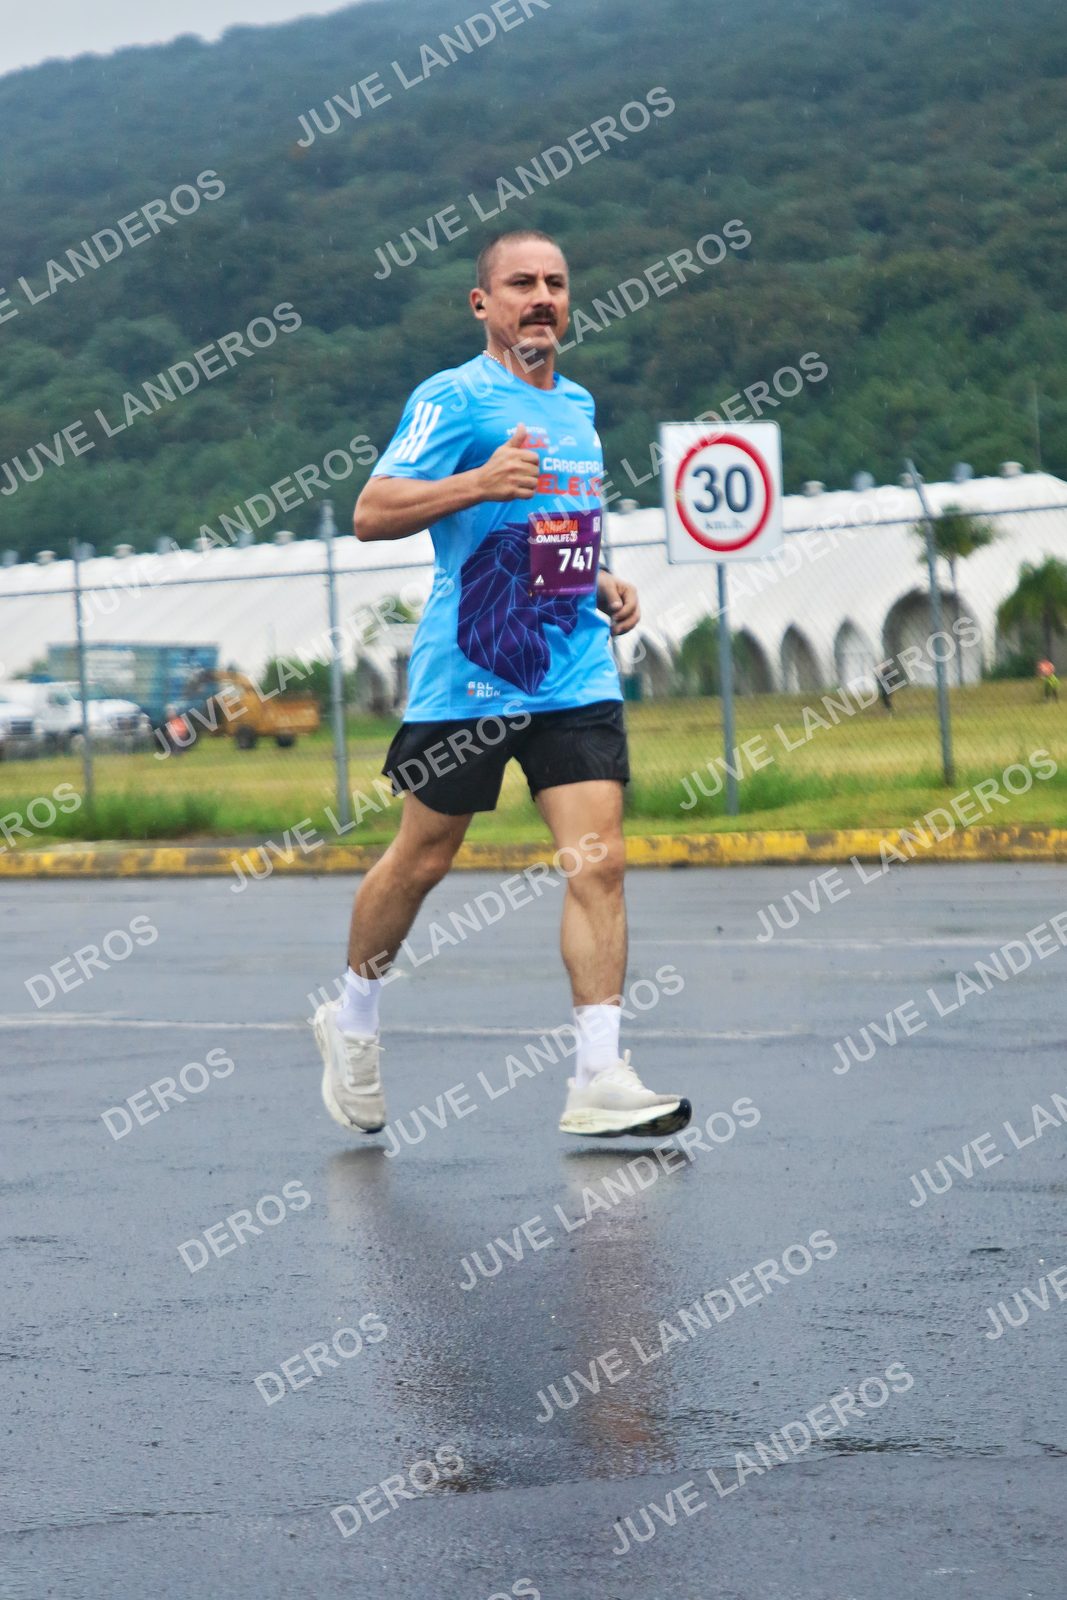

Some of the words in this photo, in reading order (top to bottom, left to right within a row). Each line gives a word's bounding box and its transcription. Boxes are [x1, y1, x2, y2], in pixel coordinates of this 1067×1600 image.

[542, 457, 603, 474] CARRERA
[692, 464, 754, 513] 30
[558, 546, 594, 573] 747
